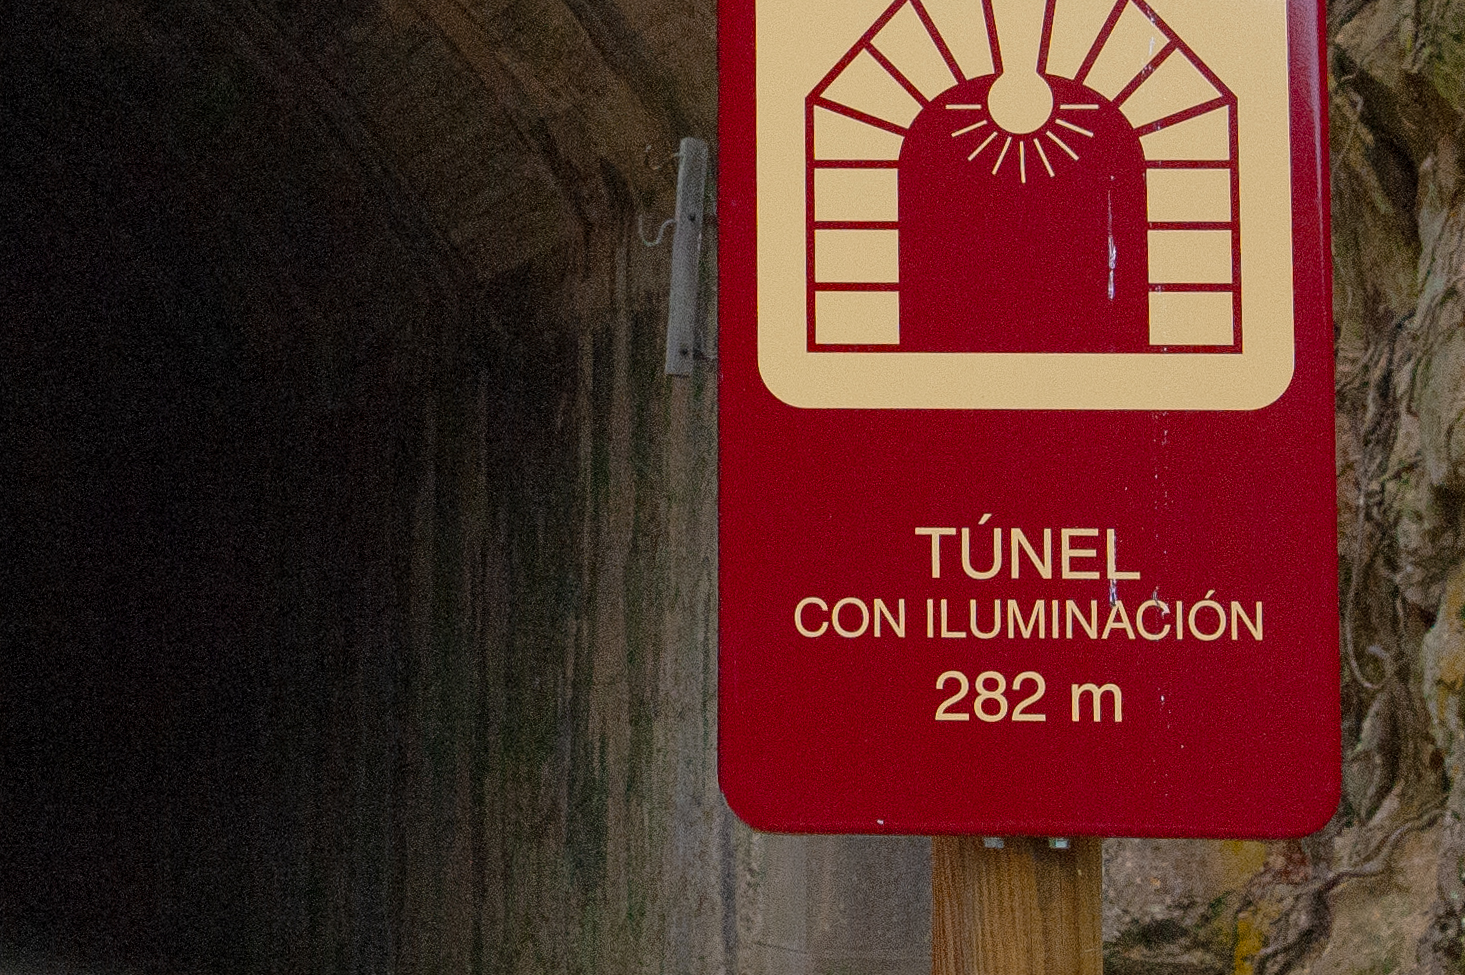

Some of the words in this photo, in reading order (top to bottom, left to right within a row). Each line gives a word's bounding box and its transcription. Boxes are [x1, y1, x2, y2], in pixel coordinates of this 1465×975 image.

[914, 513, 1141, 581] TÚNEL
[794, 597, 905, 638] CON
[926, 589, 1263, 641] ILUMINACIÓN
[935, 670, 1046, 722] 282
[1071, 682, 1124, 723] m
